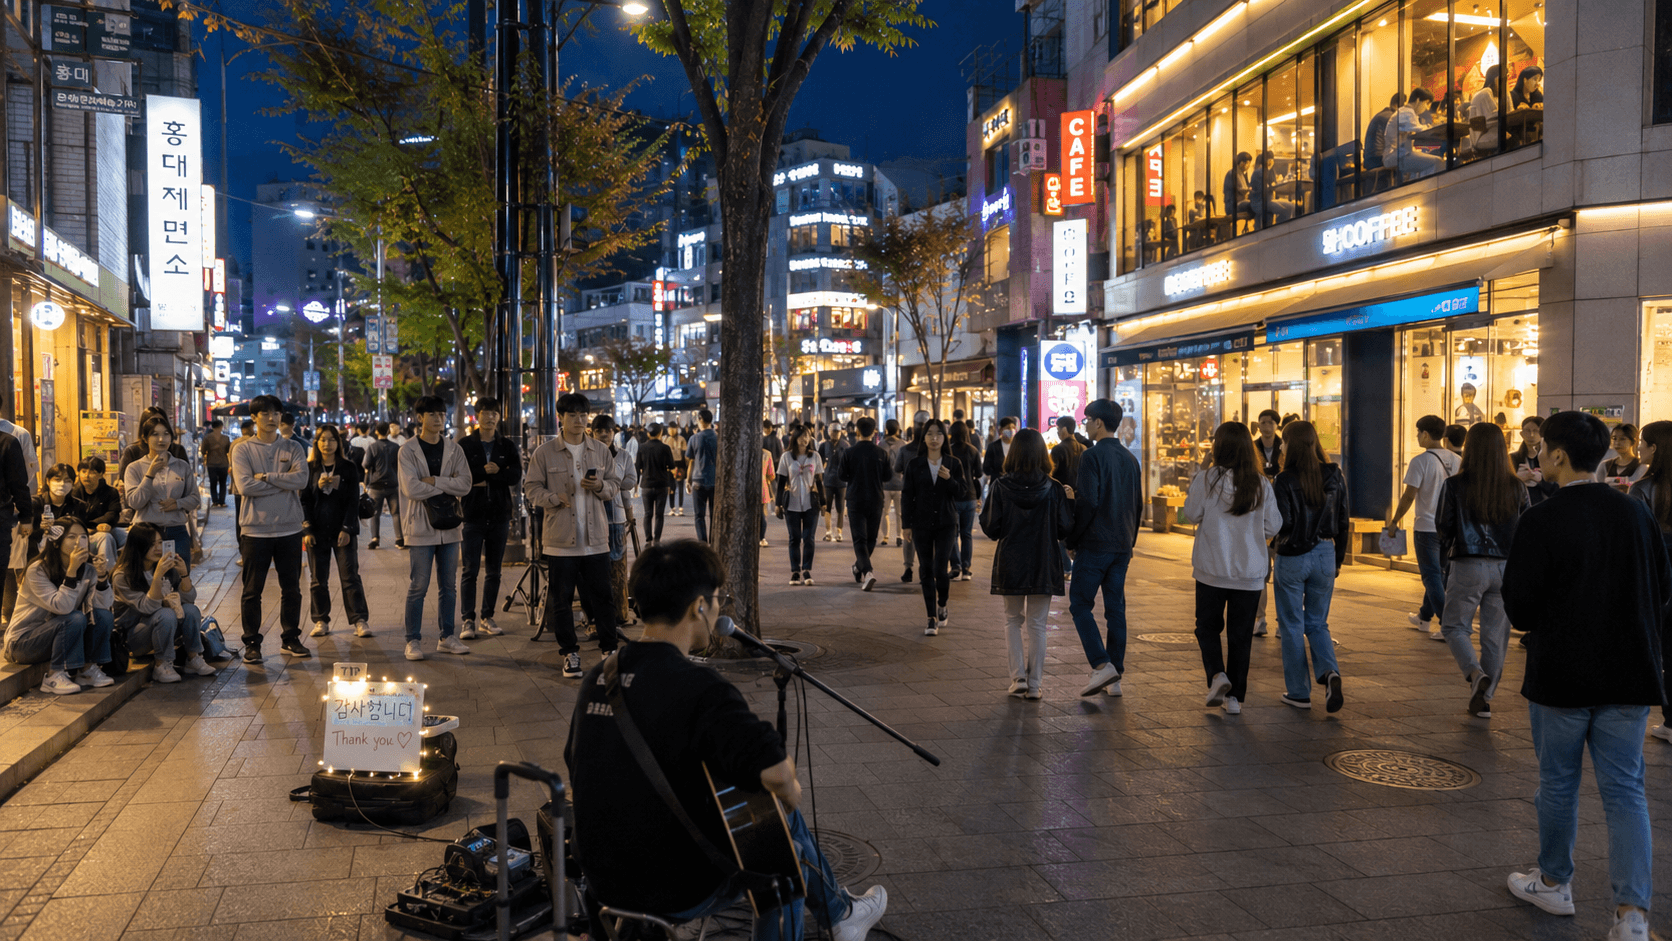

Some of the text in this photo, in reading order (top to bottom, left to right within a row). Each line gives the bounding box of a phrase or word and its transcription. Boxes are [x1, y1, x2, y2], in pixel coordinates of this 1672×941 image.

[1069, 118, 1085, 197] CAFE
[161, 120, 189, 275] 홍대제면소
[332, 730, 394, 751] Thank you
